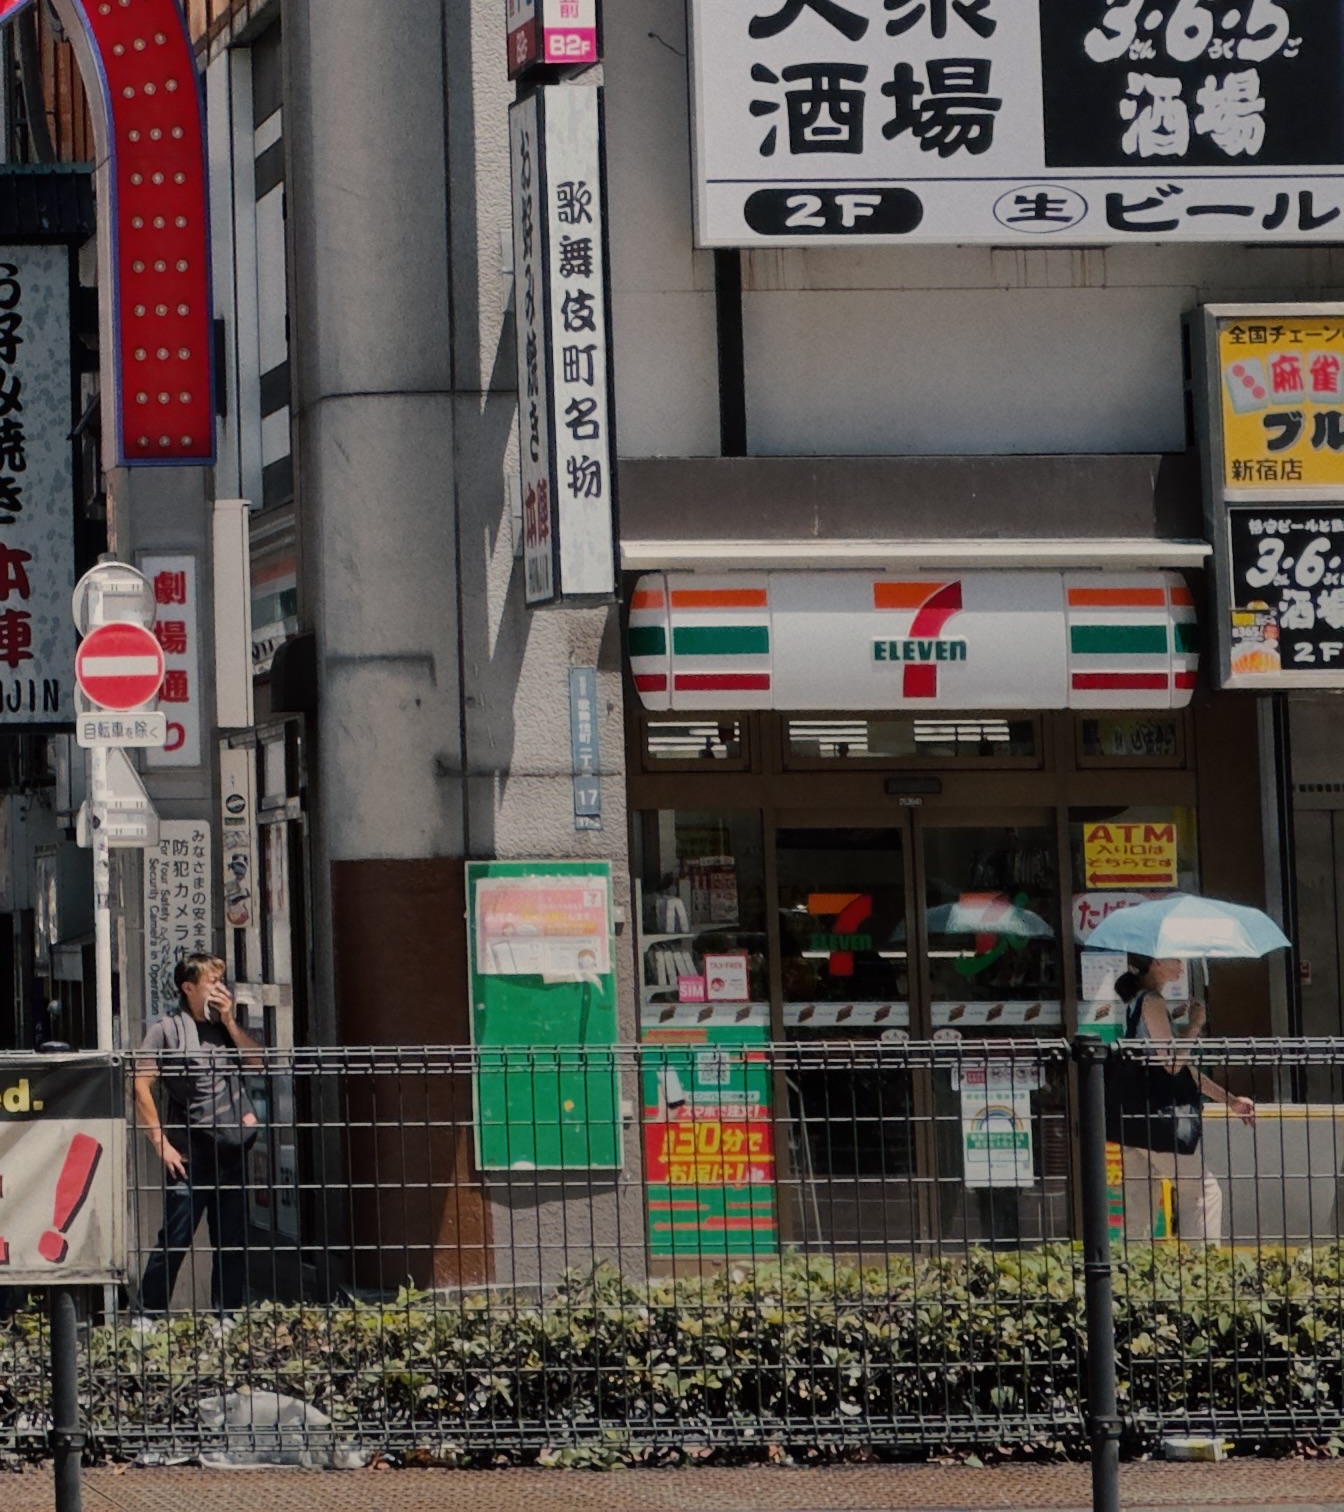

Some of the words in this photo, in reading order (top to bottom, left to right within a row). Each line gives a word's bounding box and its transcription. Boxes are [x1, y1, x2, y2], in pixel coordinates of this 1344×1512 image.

[548, 33, 591, 58] B2F
[749, 57, 1003, 159] 酒場
[1118, 68, 1266, 158] 酒場
[785, 194, 882, 228] 2F
[1006, 194, 1074, 223] 生
[1105, 183, 1341, 231] ビール
[556, 180, 602, 500] 歌舞伎町名物
[1228, 325, 1344, 345] 全国チェーン
[1271, 353, 1341, 394] 麻雀
[1231, 458, 1303, 482] 新宿店
[874, 580, 963, 697] 7
[1293, 641, 1344, 663] 2F
[153, 570, 190, 752] 劇場通り
[84, 722, 159, 741] 自転車を除く
[578, 789, 598, 806] 17
[1086, 825, 1175, 844] ATM
[1097, 844, 1165, 856] 入り口は
[148, 858, 159, 901] Security
[160, 861, 170, 885] Your
[150, 906, 160, 946] Camera
[150, 964, 160, 1015] Operation
[679, 984, 704, 998] SIM
